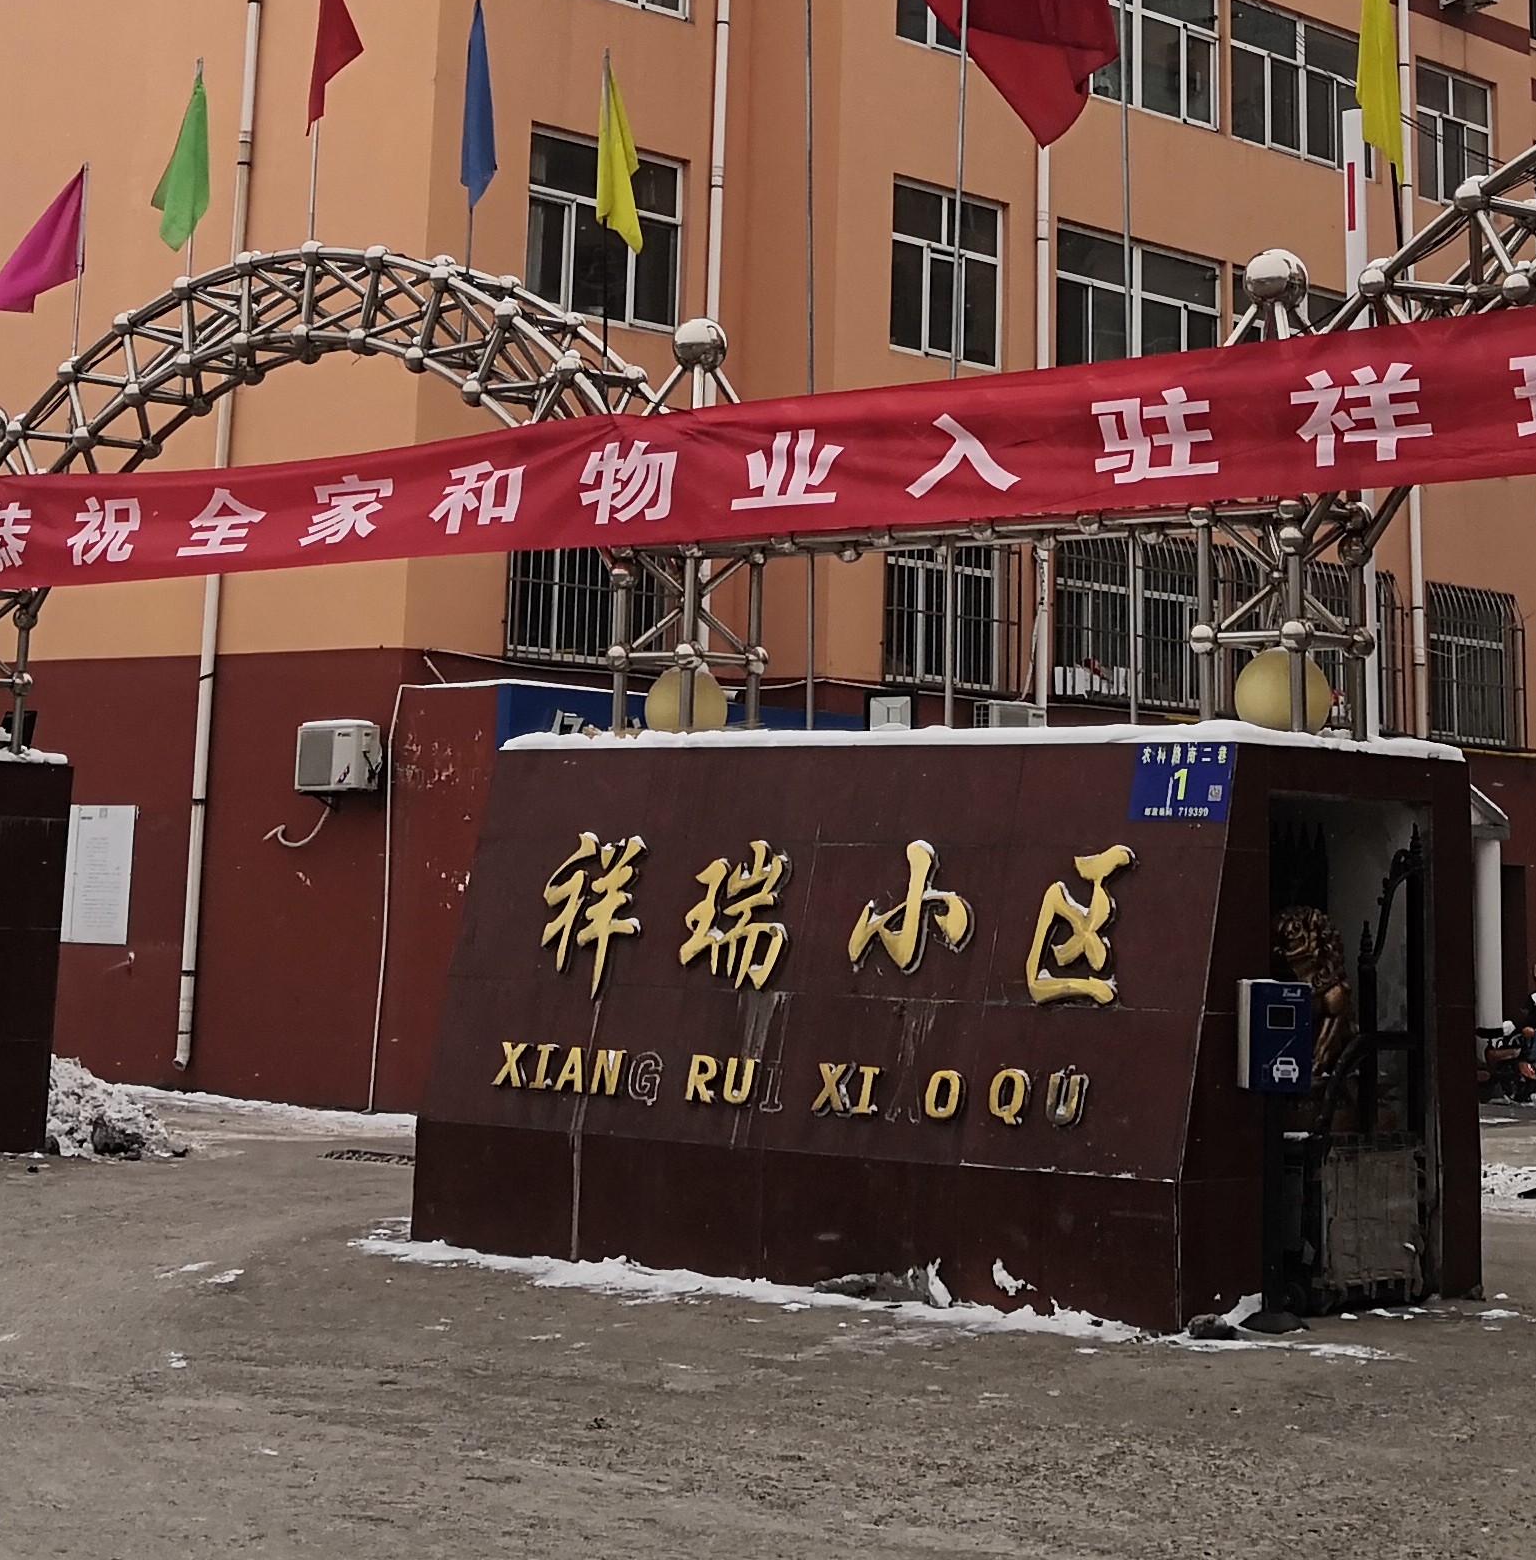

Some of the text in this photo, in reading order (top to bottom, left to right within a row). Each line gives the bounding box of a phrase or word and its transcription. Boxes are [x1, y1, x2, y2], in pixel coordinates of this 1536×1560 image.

[1174, 768, 1188, 801] 1
[542, 832, 1139, 1007] 祥瑞小区
